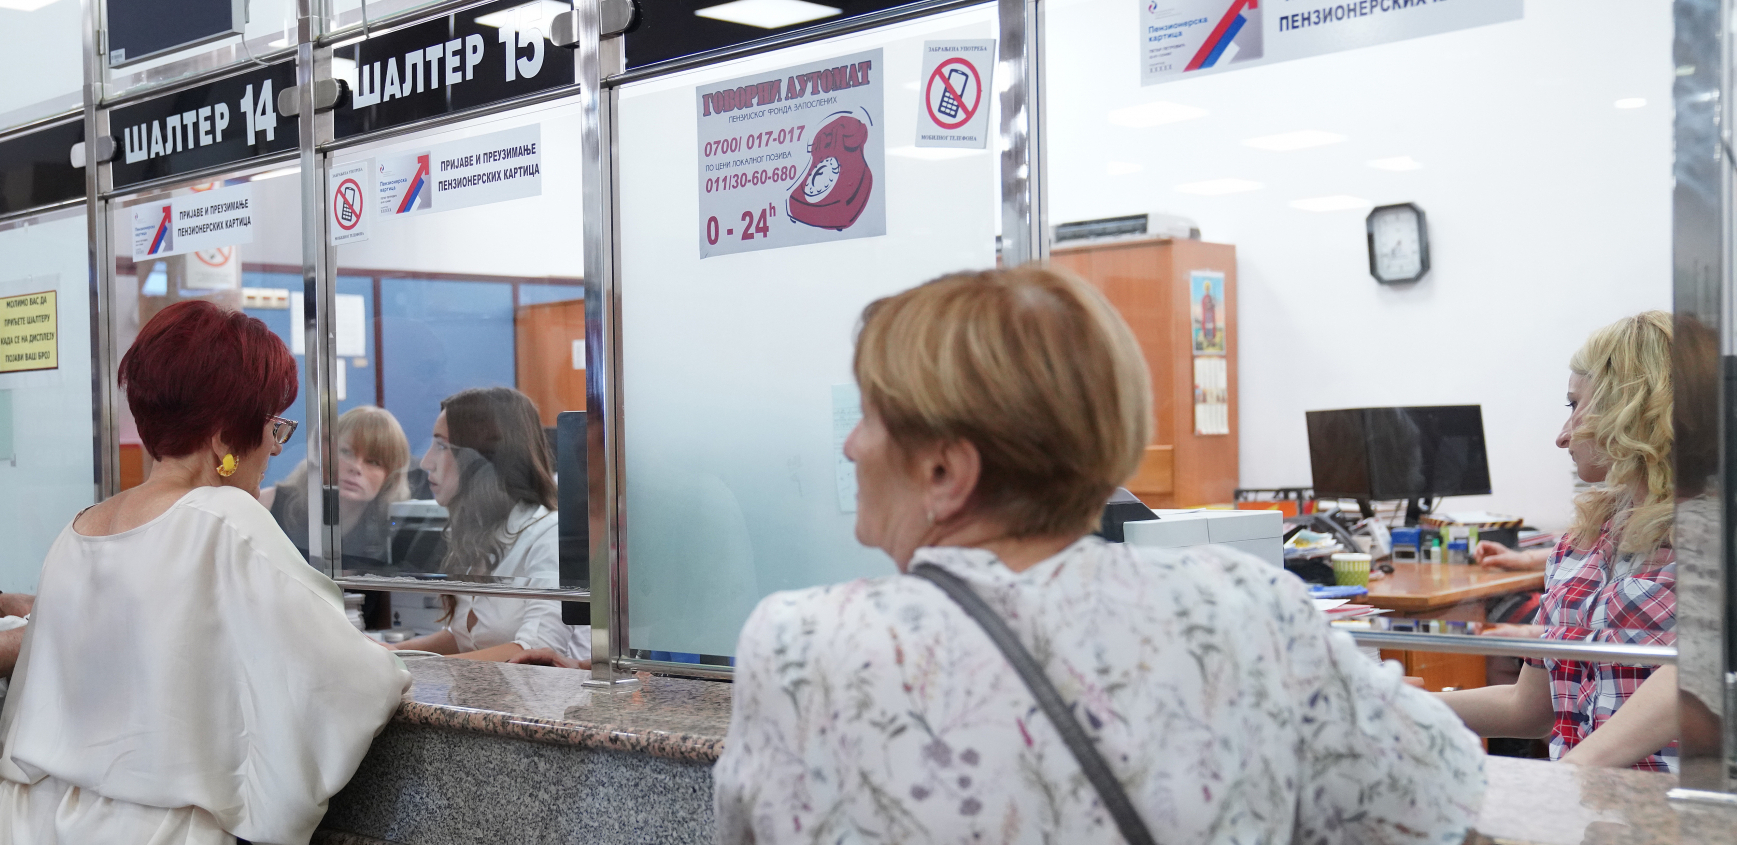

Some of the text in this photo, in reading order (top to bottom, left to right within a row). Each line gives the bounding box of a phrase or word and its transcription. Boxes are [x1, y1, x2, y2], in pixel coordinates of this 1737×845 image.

[1148, 17, 1208, 34] Пензионерска
[1149, 31, 1182, 42] картица
[352, 2, 545, 110] ШАЛТЕР 15
[702, 60, 872, 117] ГОВОРНИ АУТОМАТ
[124, 79, 277, 164] ШАЛТЕР 14
[728, 96, 838, 123] ПЕНЗИЈСКОГ ФОНДА ЗАПОСЛЕНИХ
[704, 125, 805, 157] 0700/ 017-017
[440, 143, 536, 172] ПРИЈАВЕ И ПРЕУЗИМАЊЕ
[706, 151, 792, 172] ПО ЦЕНИ ЛОКАЛНОГ ПОЗИВА
[438, 163, 540, 192] ПЕНЗИОНЕРСКИХ КАРТИЦА
[706, 165, 796, 193] 011/30-60-680
[179, 199, 249, 220] ПРИЈАВЕ И ПРЕУЗИМАЊЕ
[178, 216, 251, 237] ПЕНЗИОНЕРСКИХ КАРТИЦА
[707, 216, 719, 245] 0
[7, 296, 47, 308] МОЛИМО ВАС ДА
[27, 314, 50, 325] ШАЛТЕРУ
[0, 337, 13, 346] КАДА
[15, 336, 20, 344] СЕ
[21, 335, 28, 343] НА
[6, 354, 24, 363] ПОЈАВИ
[25, 352, 37, 361] ВАШ
